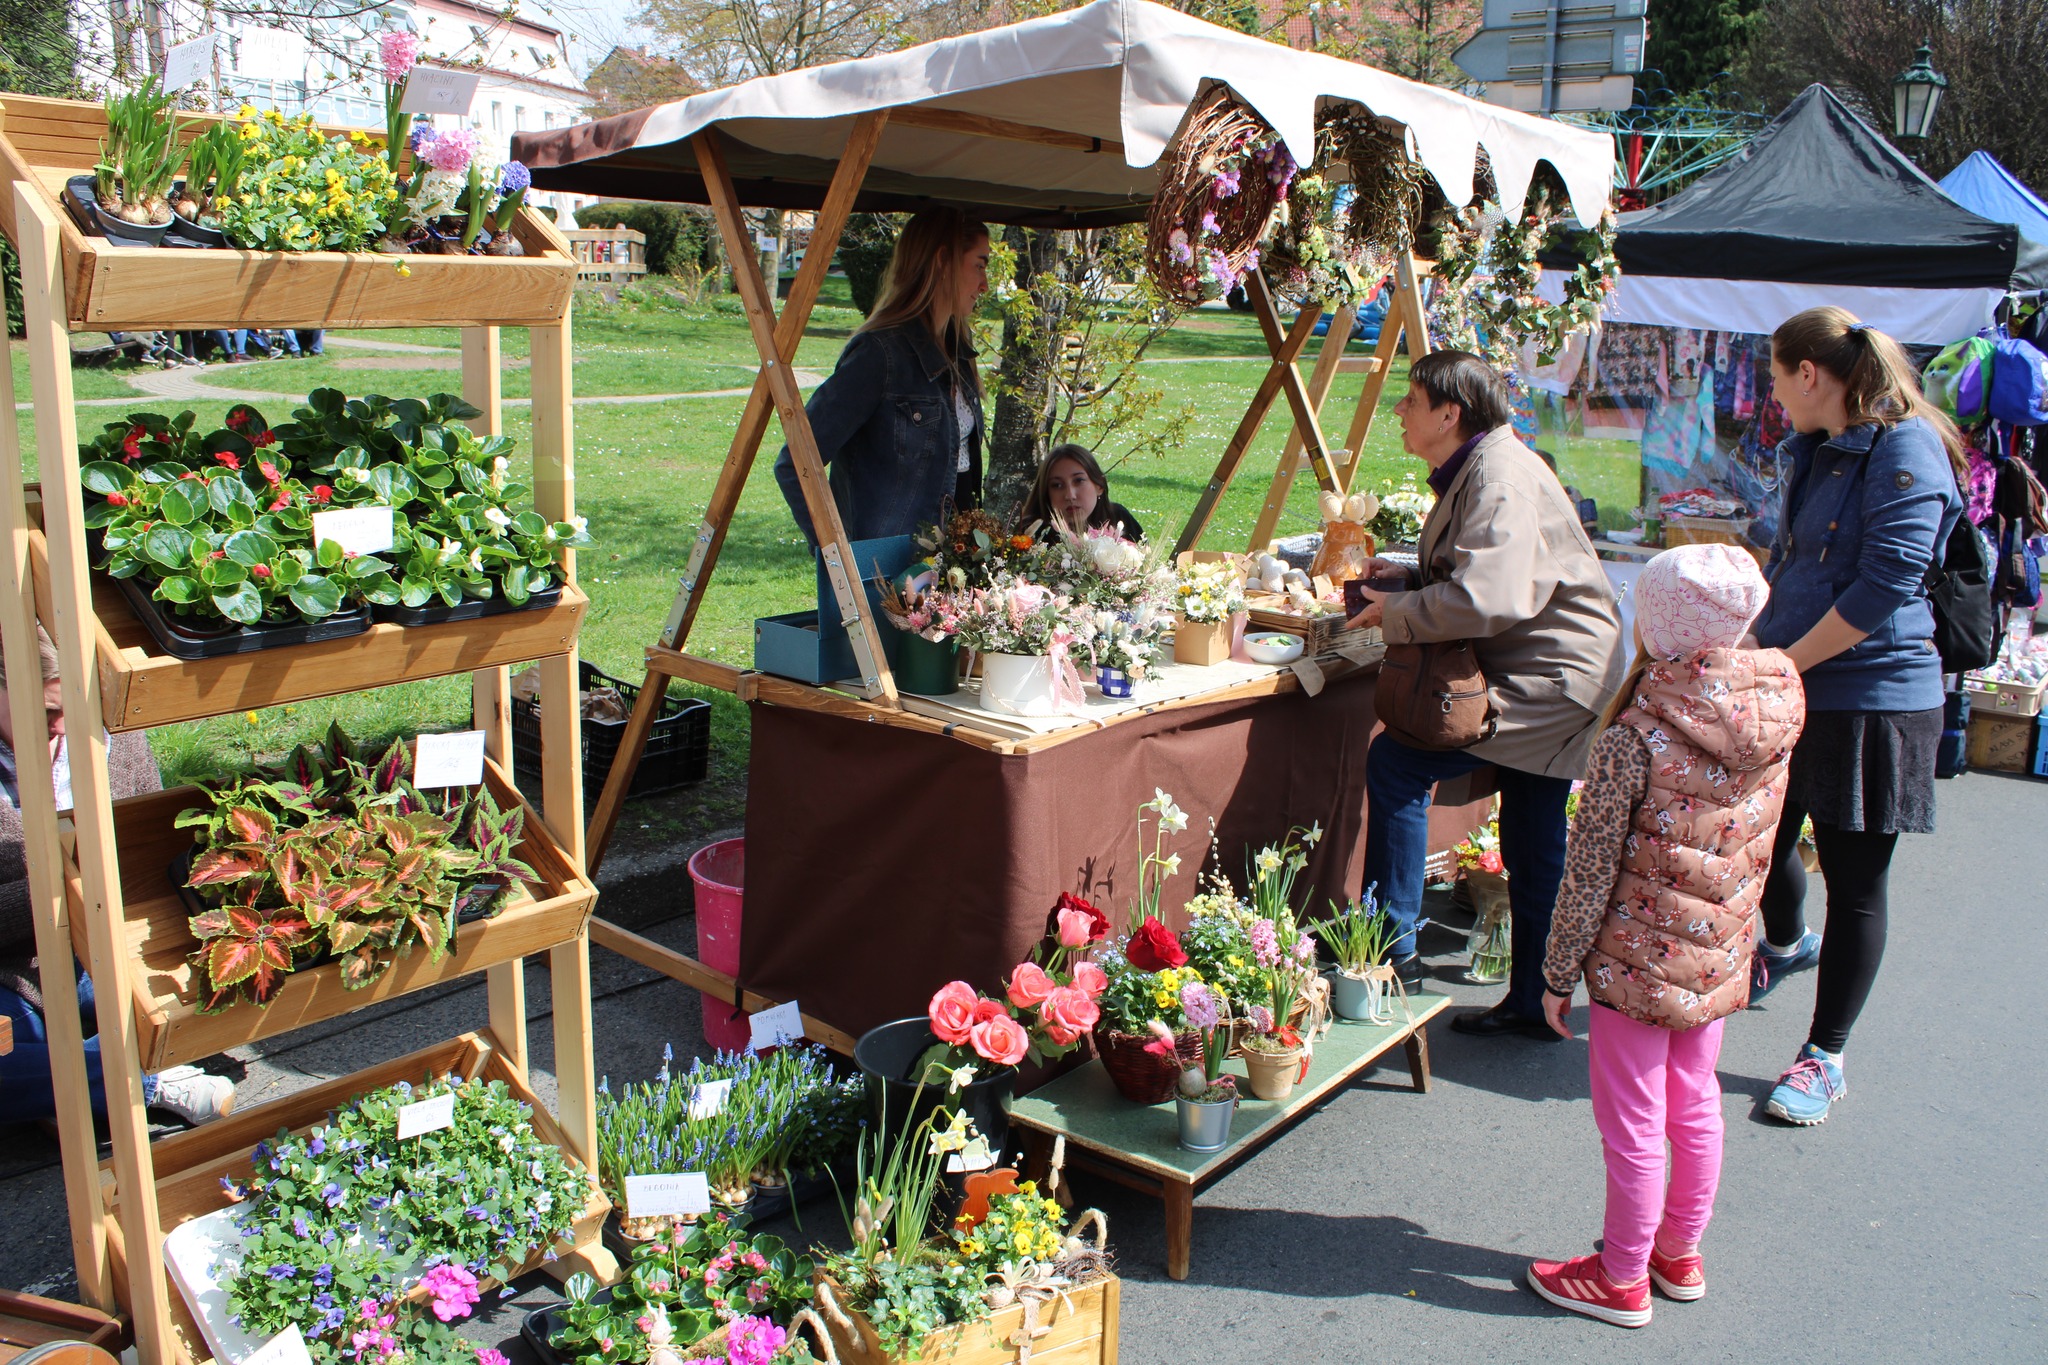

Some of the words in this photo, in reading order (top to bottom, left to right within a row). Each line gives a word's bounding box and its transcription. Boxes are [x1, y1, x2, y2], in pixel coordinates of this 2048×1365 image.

[731, 456, 737, 467] 2
[802, 467, 809, 479] 2
[837, 578, 845, 591] 2
[828, 1034, 836, 1047] 5
